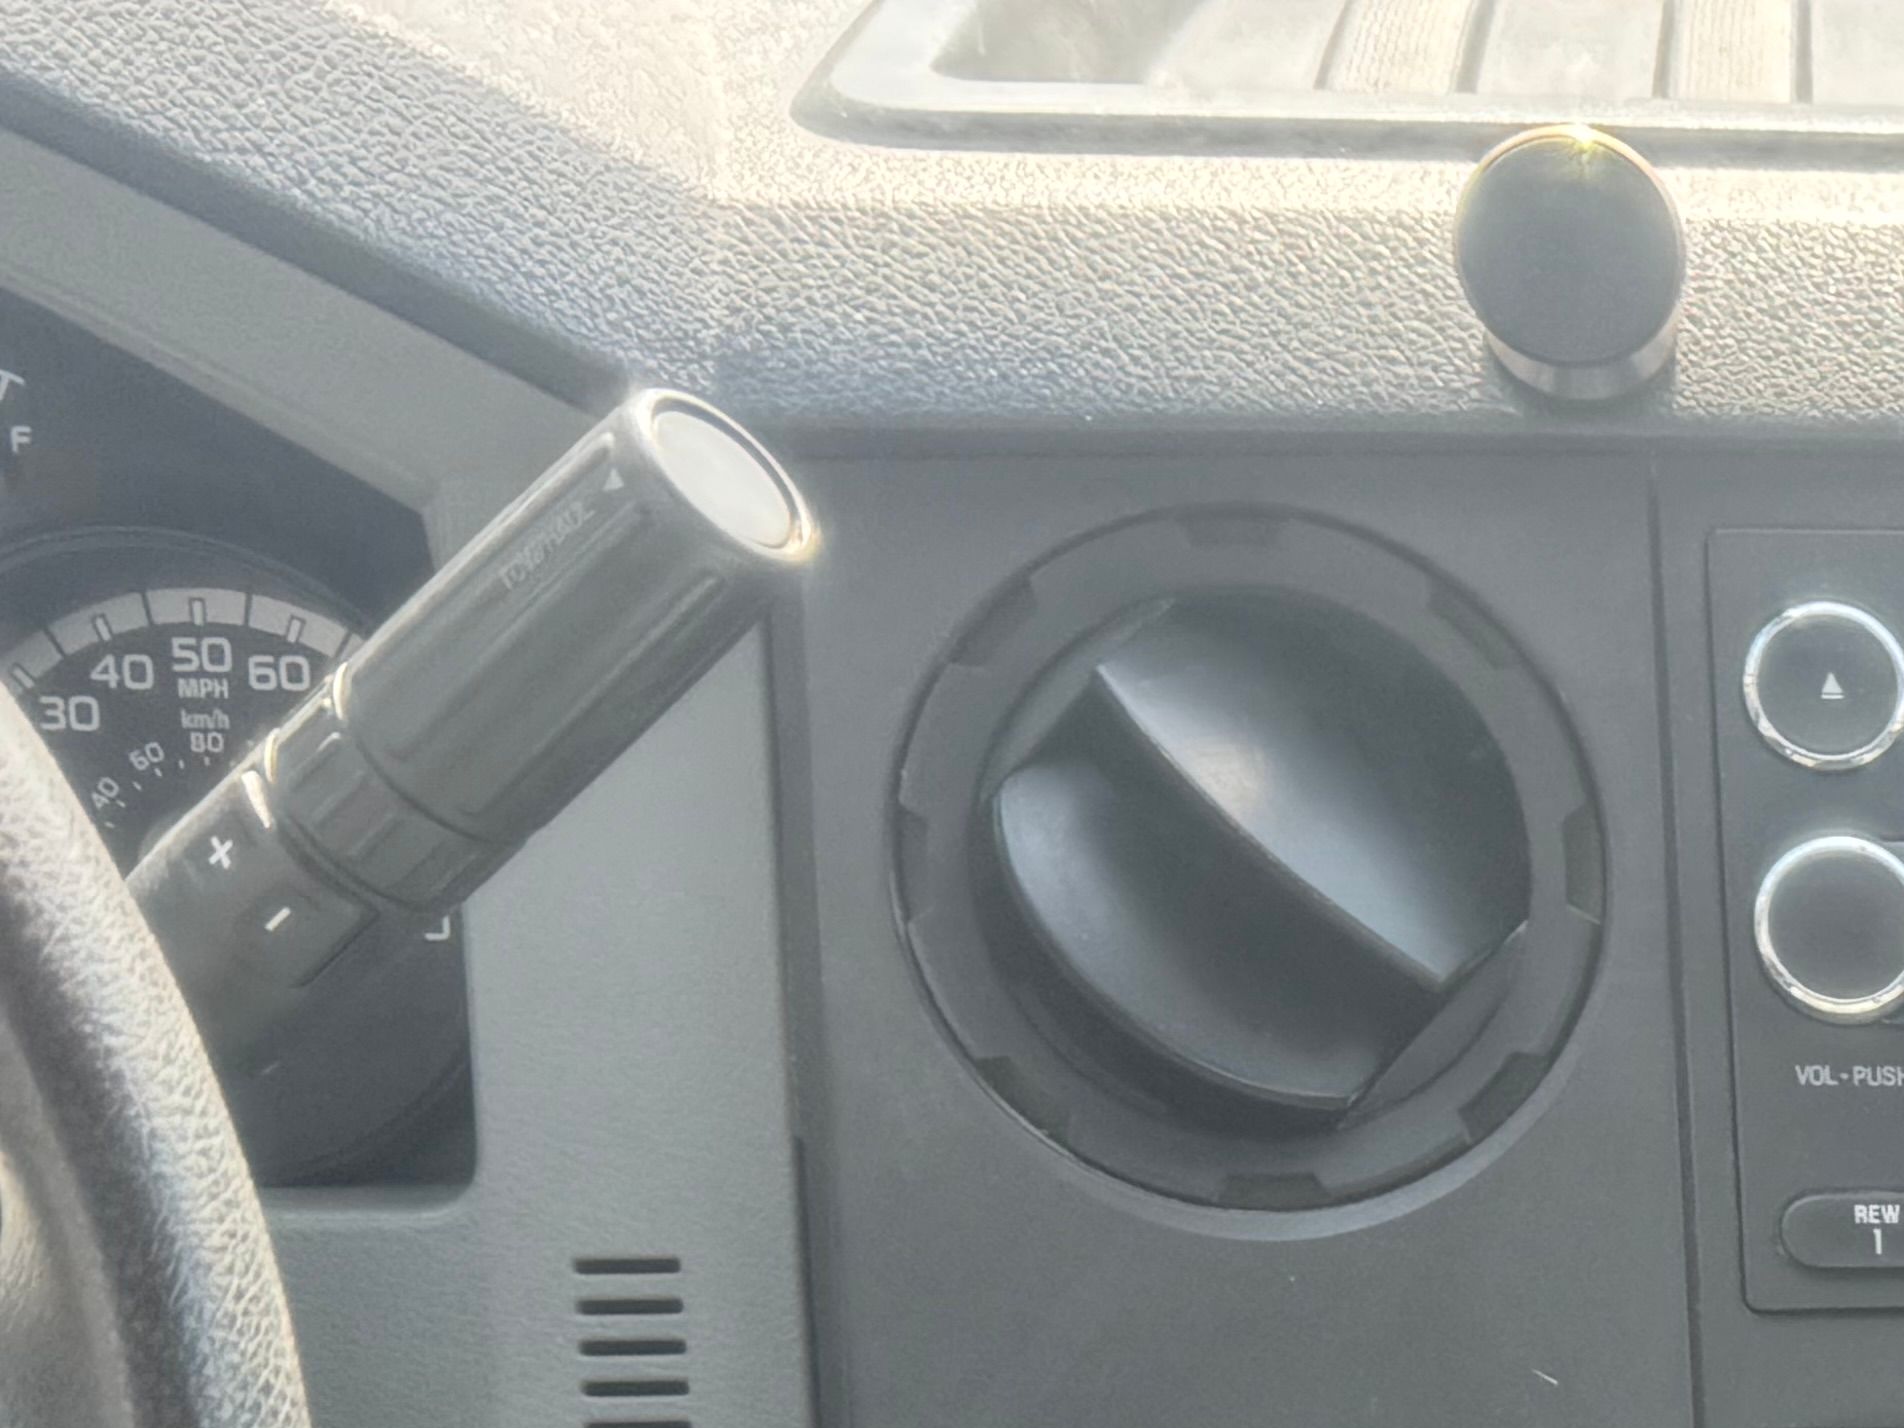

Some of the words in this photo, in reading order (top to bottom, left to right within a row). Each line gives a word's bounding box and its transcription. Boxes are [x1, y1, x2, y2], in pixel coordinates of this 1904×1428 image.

[10, 425, 33, 454] F
[170, 636, 234, 673] 50
[89, 653, 155, 691] 40
[247, 654, 311, 692] 60
[176, 677, 230, 700] MPH
[38, 695, 101, 732] 30
[179, 707, 231, 730] km/h
[128, 741, 165, 772] 60
[189, 731, 225, 753] 80
[90, 776, 121, 810] 40
[1854, 1204, 1901, 1225] REW
[1872, 1228, 1884, 1255] 1
